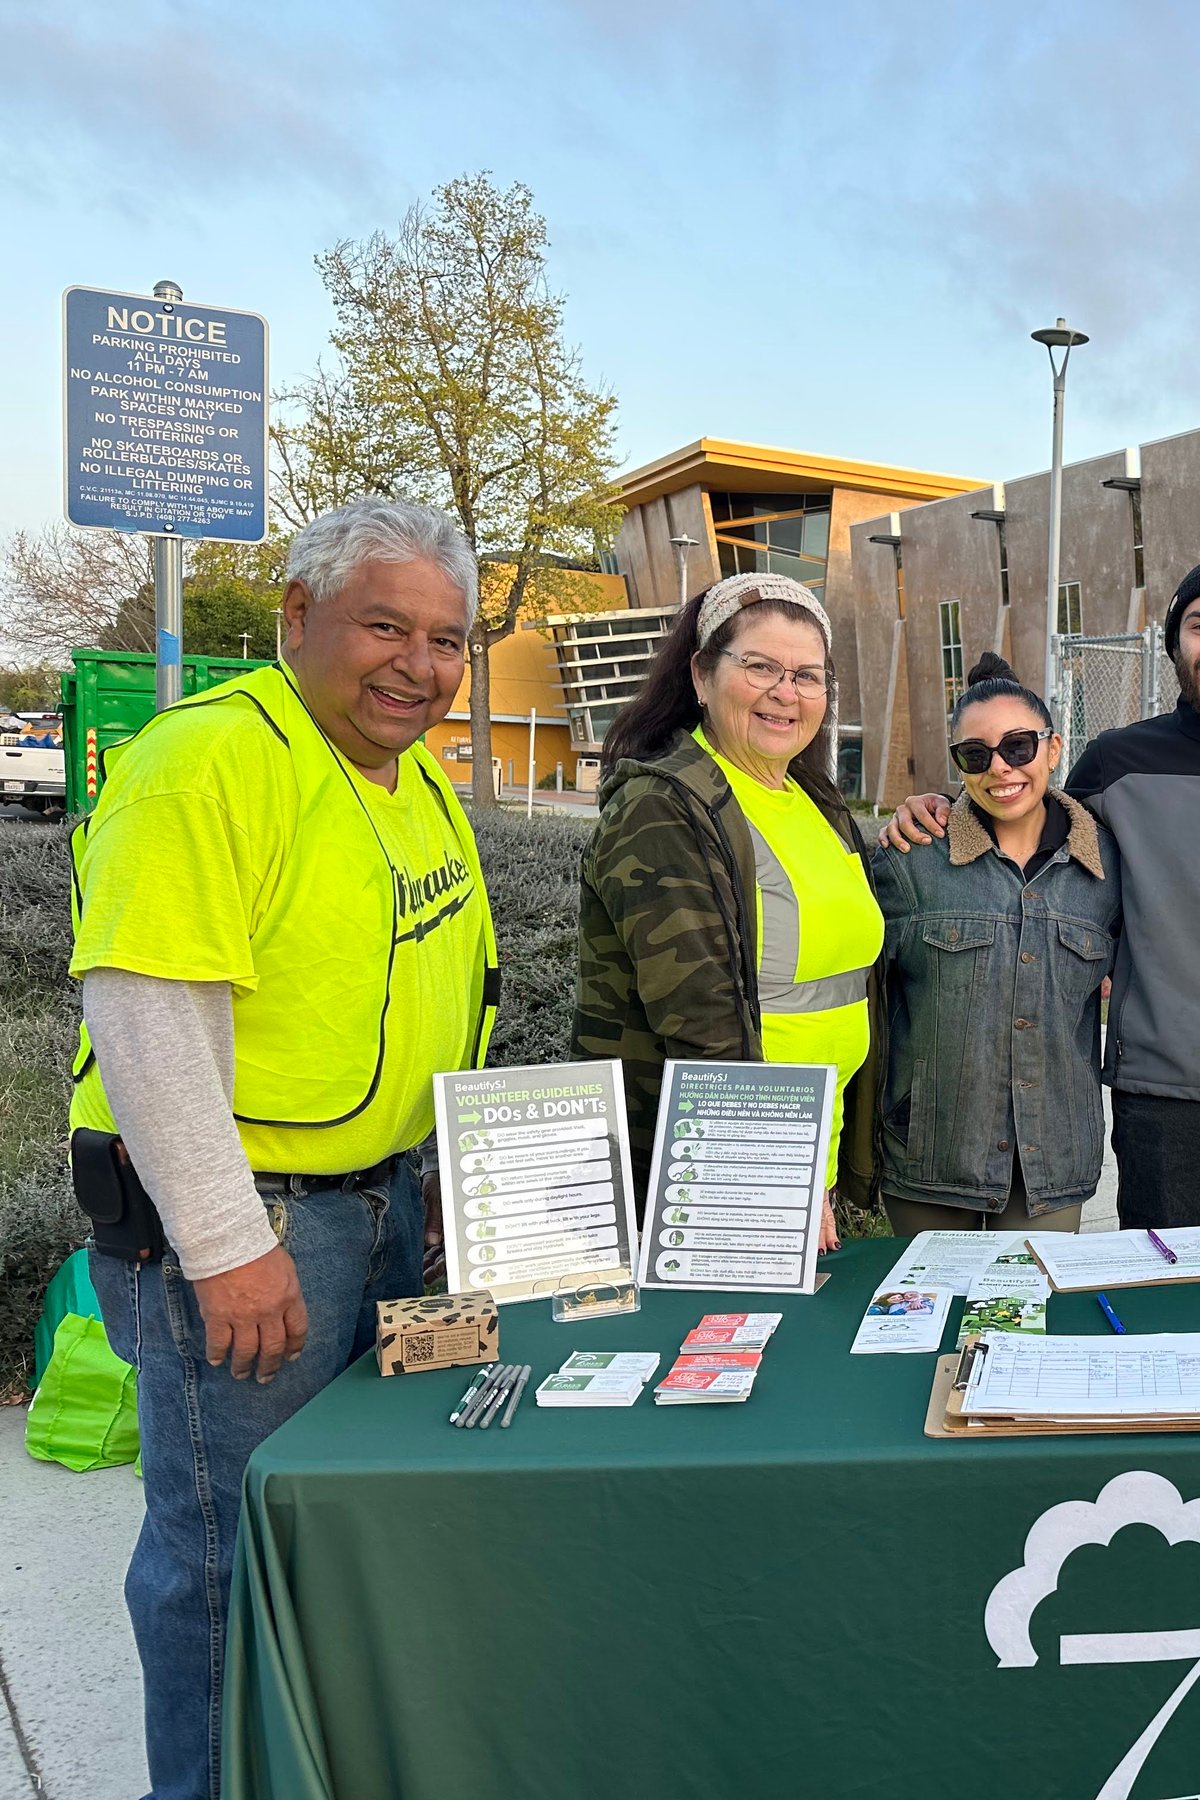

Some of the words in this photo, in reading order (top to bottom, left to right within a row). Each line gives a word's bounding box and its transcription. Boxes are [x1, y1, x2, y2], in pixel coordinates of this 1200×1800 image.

[107, 306, 227, 344] NOTICE
[92, 335, 155, 352] PARKING
[159, 344, 241, 364] PROHIBITED
[134, 352, 161, 364] ALL
[165, 356, 201, 368] DAYS
[127, 361, 140, 371] 11
[145, 363, 165, 375] PM
[178, 367, 183, 377] 7
[188, 369, 208, 380] AM
[71, 368, 91, 380] NO
[94, 372, 161, 389] ALCOHOL
[165, 380, 262, 402] CONSUMPTION
[91, 386, 129, 400] PARK
[133, 390, 181, 406] WITHIN
[185, 397, 243, 414] MARKED
[120, 401, 176, 416] SPACES
[180, 407, 215, 421] ONLY
[95, 412, 115, 424] NO
[120, 415, 215, 436] TRESPASSING
[219, 428, 239, 438] OR
[131, 428, 204, 445] LOITERING
[82, 448, 251, 475] ROLLERBLADES/SKATES
[92, 438, 112, 449] NO
[116, 440, 219, 462] SKATEBOARDS
[223, 452, 243, 464] OR
[80, 463, 100, 474] NO
[105, 465, 163, 482] ILLEGAL
[167, 471, 229, 488] DUMPING
[233, 479, 253, 490] OR
[132, 478, 204, 495] LITTERING
[81, 494, 115, 502] FAILURE
[131, 499, 164, 507] COMPLY
[207, 506, 234, 515] ABOVE
[111, 503, 141, 511] RESULT
[155, 508, 190, 516] CITATION
[157, 514, 175, 522] (408)
[177, 516, 211, 524] 277-4263
[455, 1080, 506, 1093] BeautifySJ
[682, 1072, 727, 1083] BeautifySJ
[456, 1091, 530, 1107] VOLUNTEER
[535, 1084, 603, 1101] GUIDELINES
[759, 1085, 814, 1093] VOLUNTARIOS
[483, 1106, 522, 1124] DOs
[526, 1103, 539, 1119] &
[544, 1097, 606, 1118] DON'Ts
